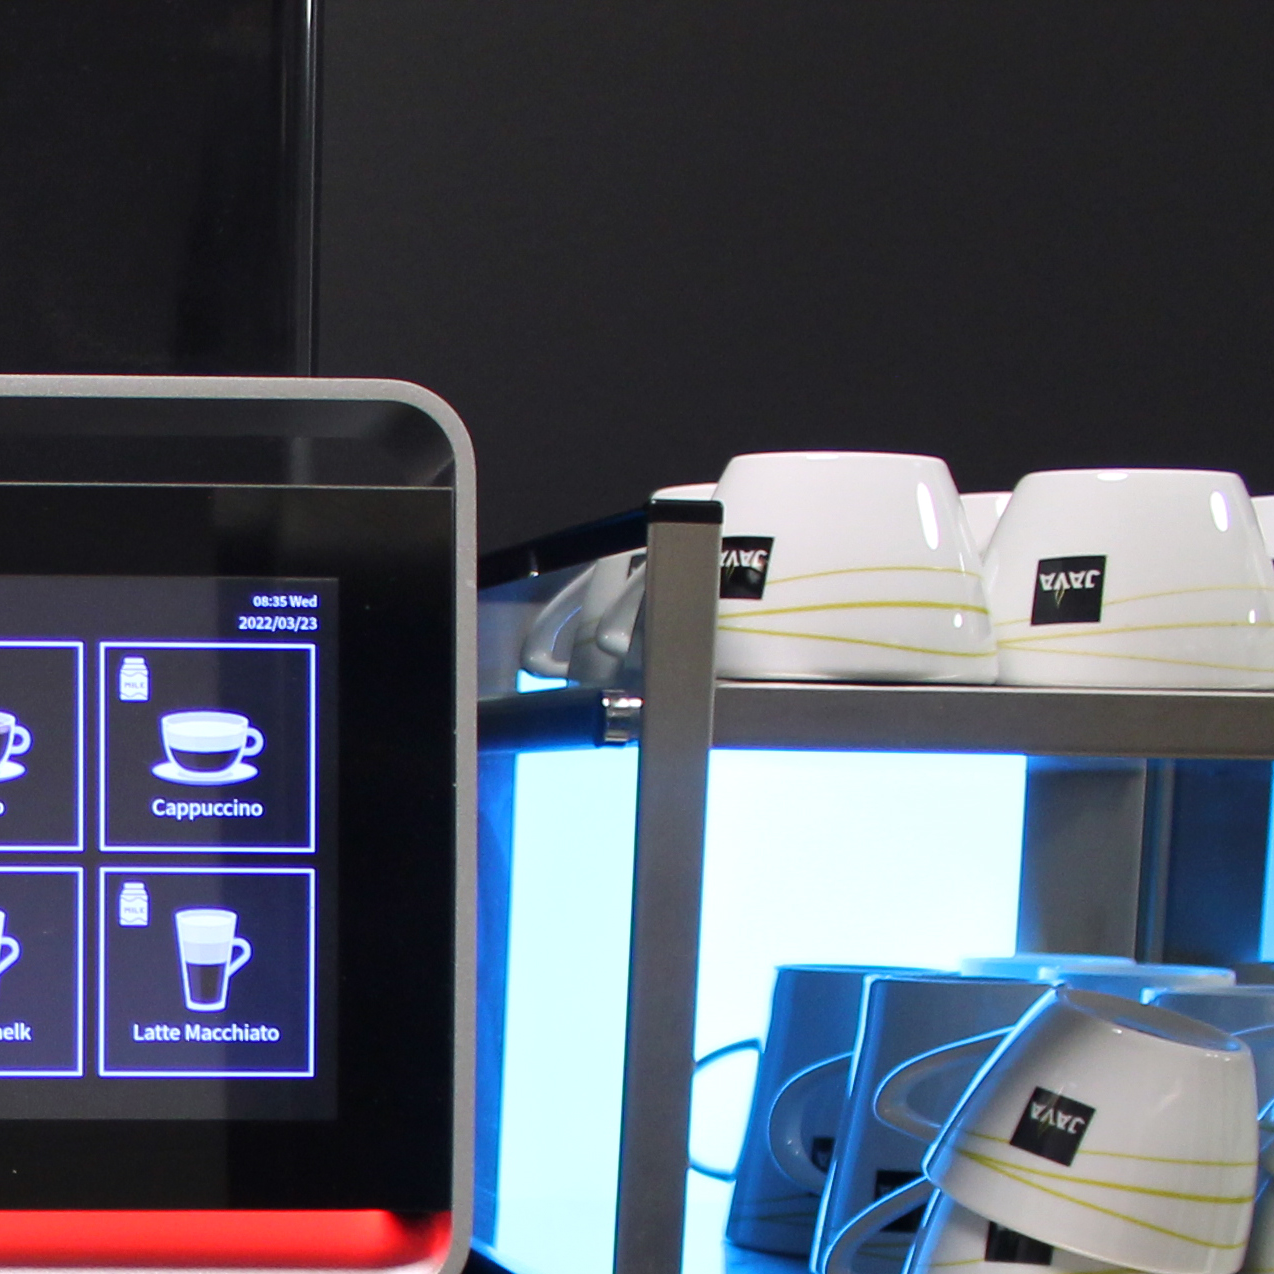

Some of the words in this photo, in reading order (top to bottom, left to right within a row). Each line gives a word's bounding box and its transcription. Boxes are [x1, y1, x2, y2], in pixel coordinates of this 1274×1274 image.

[1038, 569, 1101, 591] JAVA
[252, 595, 288, 608] 08:35
[289, 594, 318, 608] Wed
[238, 615, 318, 632] 2022/03/23
[123, 681, 146, 690] MILK
[151, 798, 263, 821] Cappuccino
[123, 906, 146, 915] MILK
[132, 1023, 181, 1042] Latte
[184, 1023, 280, 1042] Macchiato
[1030, 1101, 1086, 1134] JAVA
